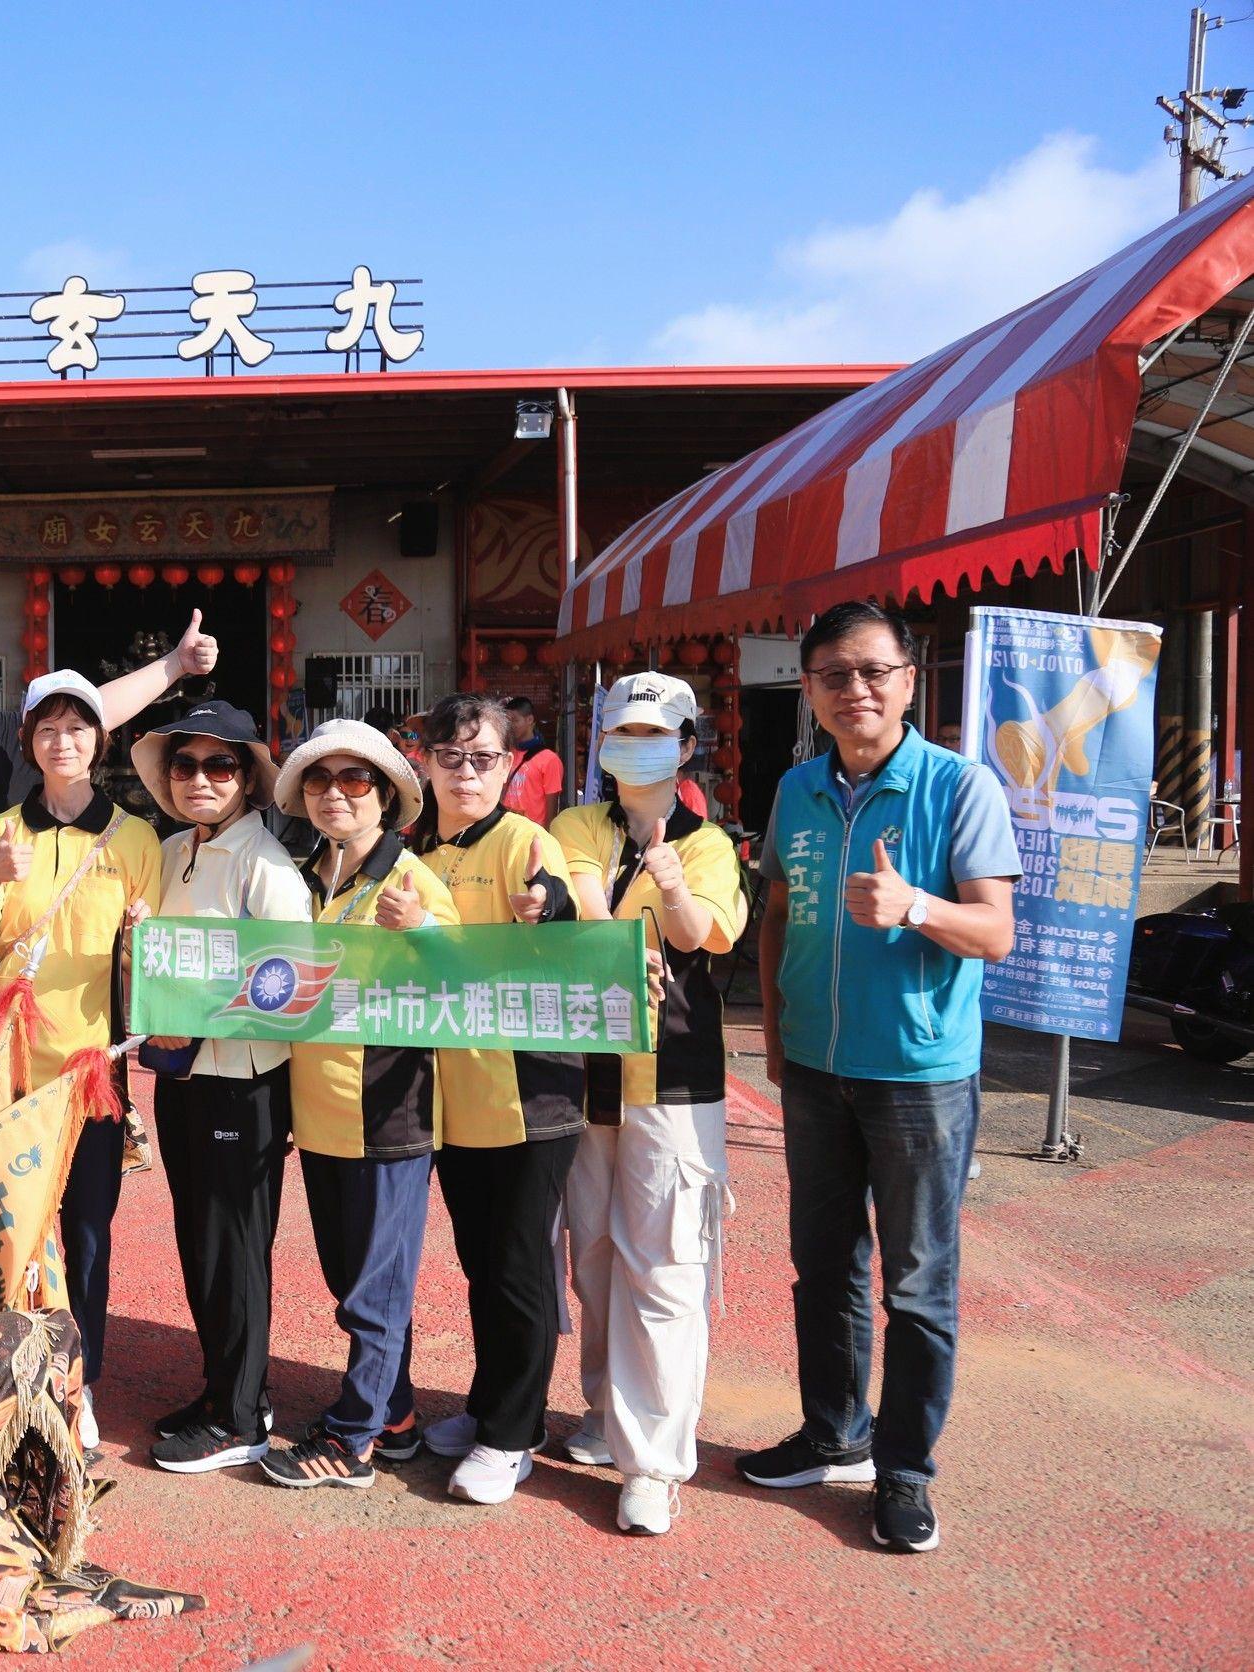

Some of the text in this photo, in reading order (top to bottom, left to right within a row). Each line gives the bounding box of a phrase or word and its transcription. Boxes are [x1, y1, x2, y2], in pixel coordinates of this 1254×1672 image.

[627, 692, 657, 703] PUMA
[787, 829, 813, 926] 王立任
[142, 927, 239, 981] 救國團
[329, 980, 635, 1042] 臺中市大雅區團委會
